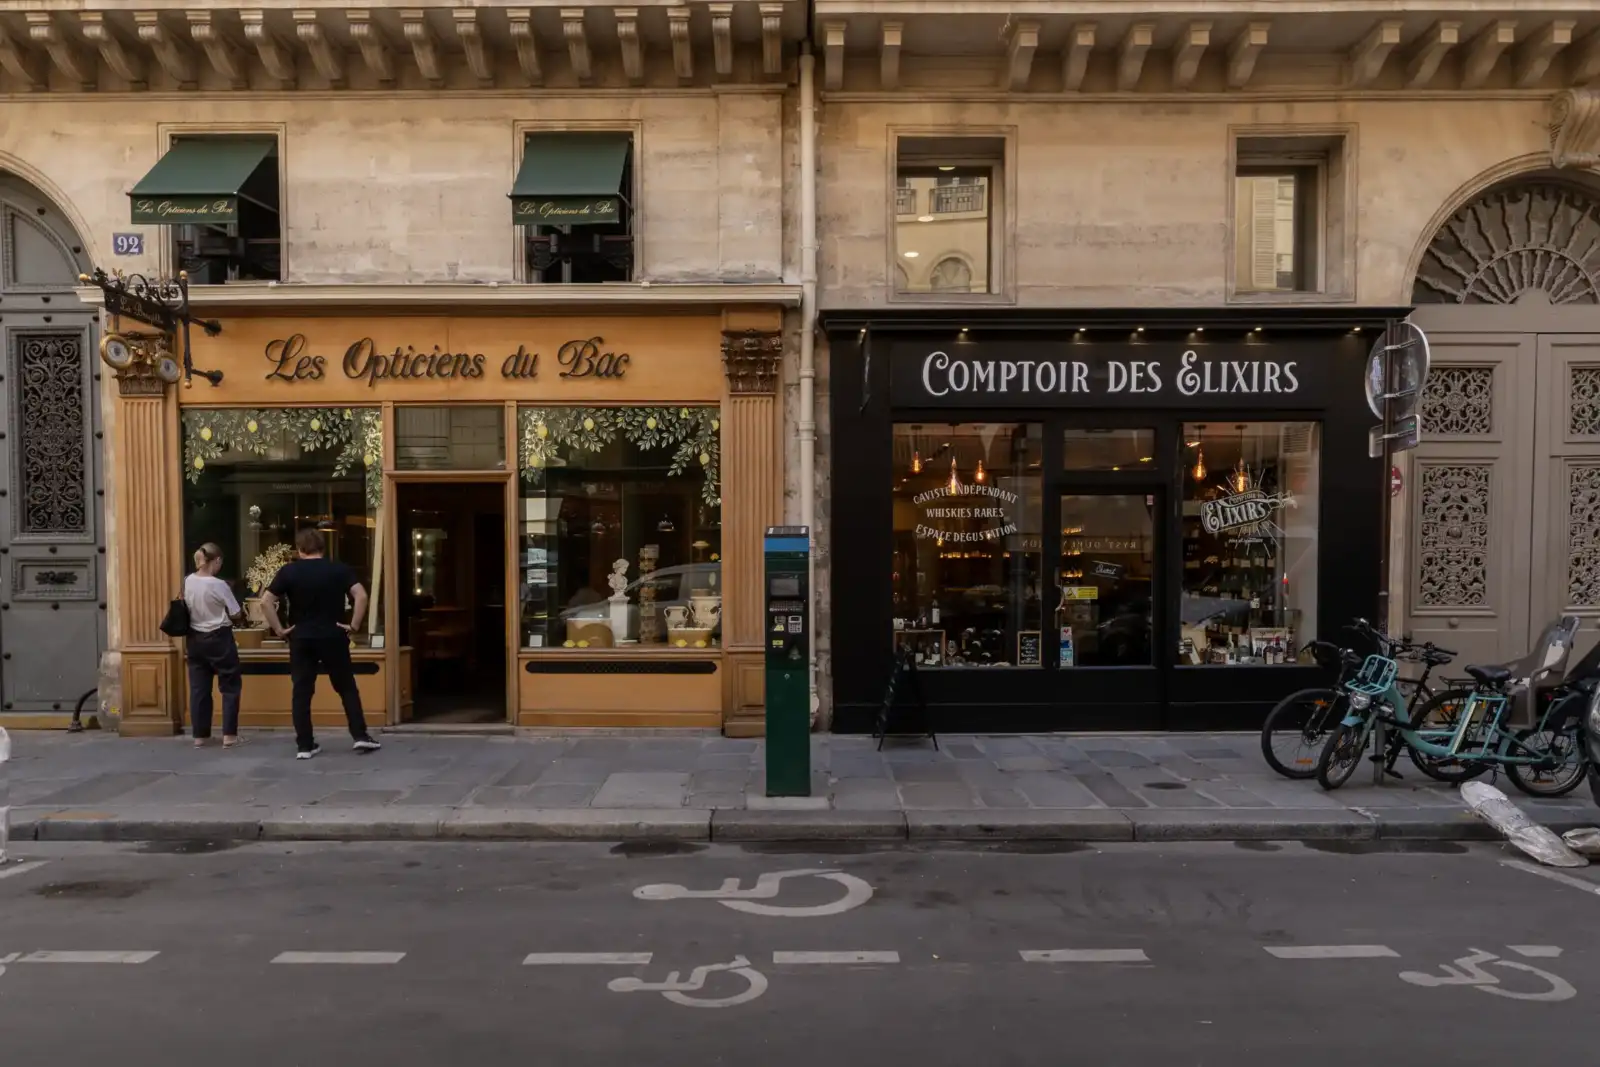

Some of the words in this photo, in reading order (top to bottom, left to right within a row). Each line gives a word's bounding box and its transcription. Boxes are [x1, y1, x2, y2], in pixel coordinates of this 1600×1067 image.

[134, 200, 154, 214] Les
[157, 200, 196, 217] Opticiens
[197, 204, 208, 214] du
[211, 200, 233, 214] Bac
[516, 201, 536, 215] Les
[539, 201, 579, 218] Opticiens
[579, 204, 590, 215] du
[593, 200, 616, 215] Bac
[117, 235, 140, 254] 92
[264, 333, 326, 382] Les
[342, 337, 486, 389] Opticiens
[501, 344, 539, 380] du
[557, 336, 632, 380] Bac
[921, 350, 1091, 396] COMPTOIR
[1106, 360, 1163, 393] DES
[1176, 349, 1300, 396] ELIXIRS
[913, 486, 951, 505] CAVISTE
[952, 483, 1019, 504] NDÉPENDANT
[926, 507, 972, 518] WHISKIES
[974, 507, 1005, 518] RARES
[1206, 501, 1266, 531] ELIXIRS
[915, 523, 952, 542] ESPACE
